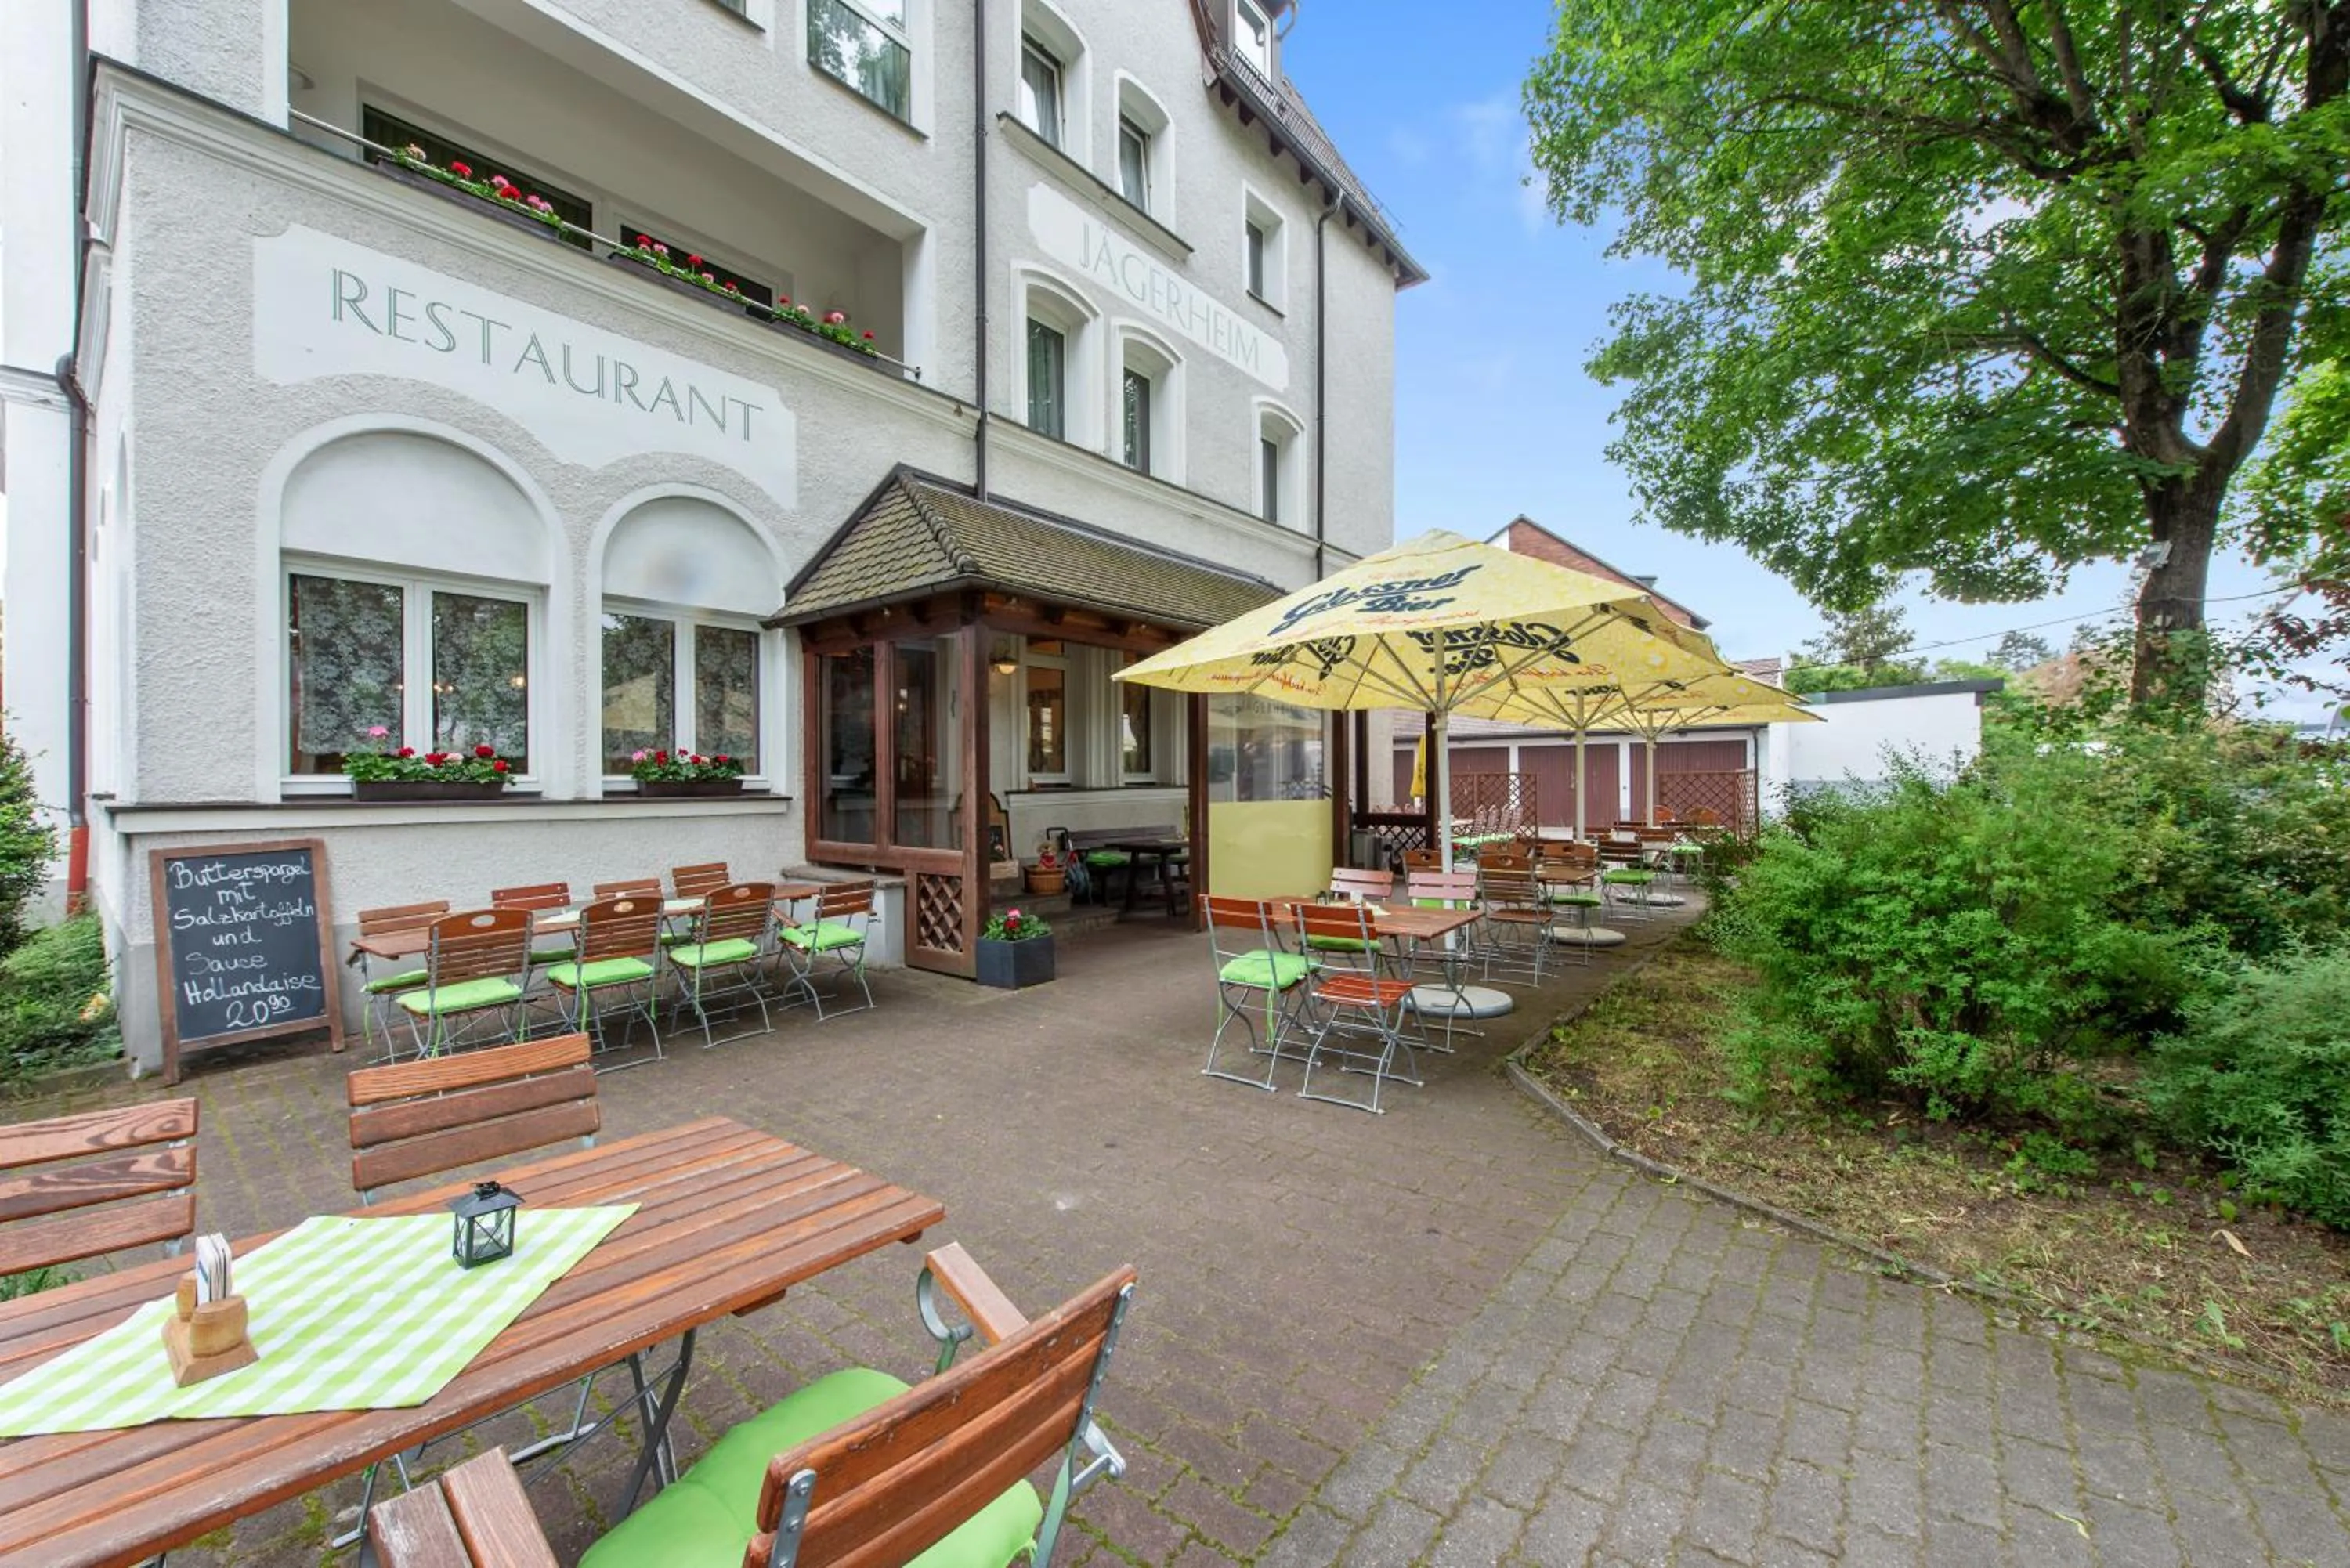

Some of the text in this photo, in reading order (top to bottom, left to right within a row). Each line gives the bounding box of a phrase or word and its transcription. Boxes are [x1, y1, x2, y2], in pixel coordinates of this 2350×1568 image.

[331, 267, 764, 442] RESTAURANT
[169, 855, 312, 889] Butterspargel
[217, 881, 256, 905] mit
[212, 925, 262, 945] und
[185, 952, 268, 976] Sauce
[183, 972, 322, 1006] Hollandaise
